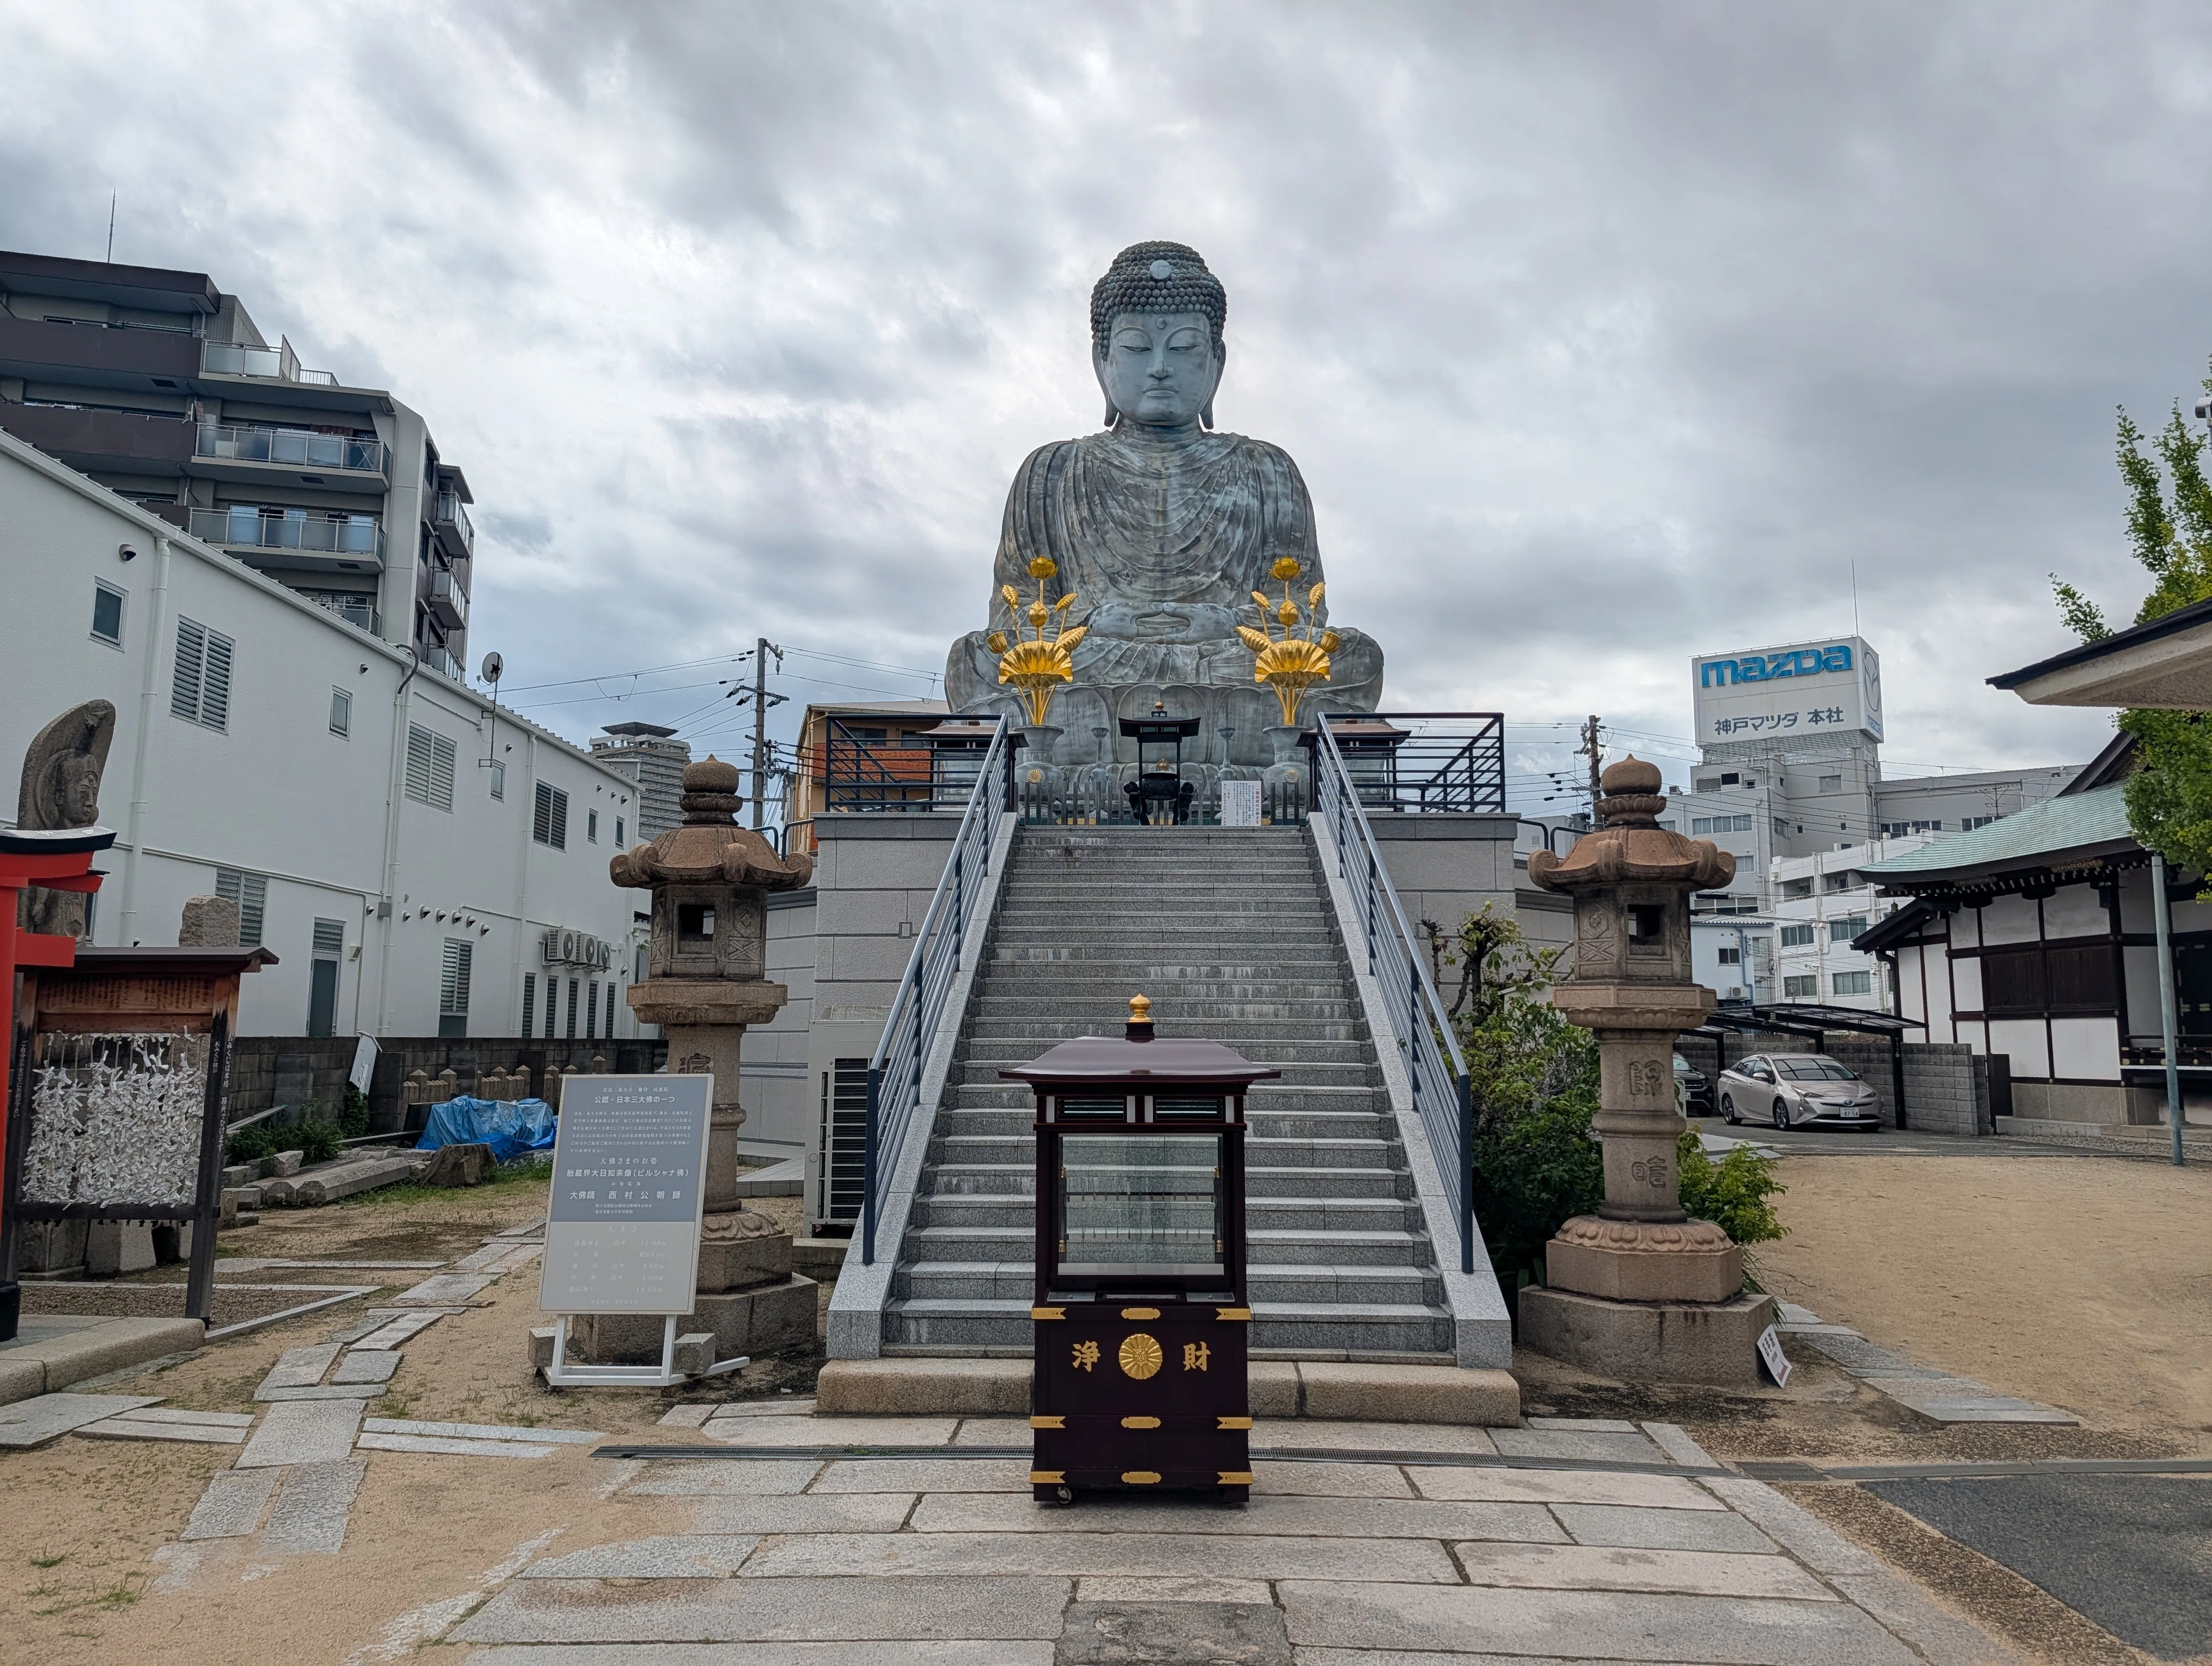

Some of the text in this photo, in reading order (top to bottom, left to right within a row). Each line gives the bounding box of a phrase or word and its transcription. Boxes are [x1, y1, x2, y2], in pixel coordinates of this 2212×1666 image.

[1714, 707, 1844, 736] 神戸マツダ 本社
[594, 1095, 675, 1104] 公認・日本三大佛の一つ
[570, 1191, 595, 1200] 大佛師
[1072, 1341, 1211, 1372] 浄 財
